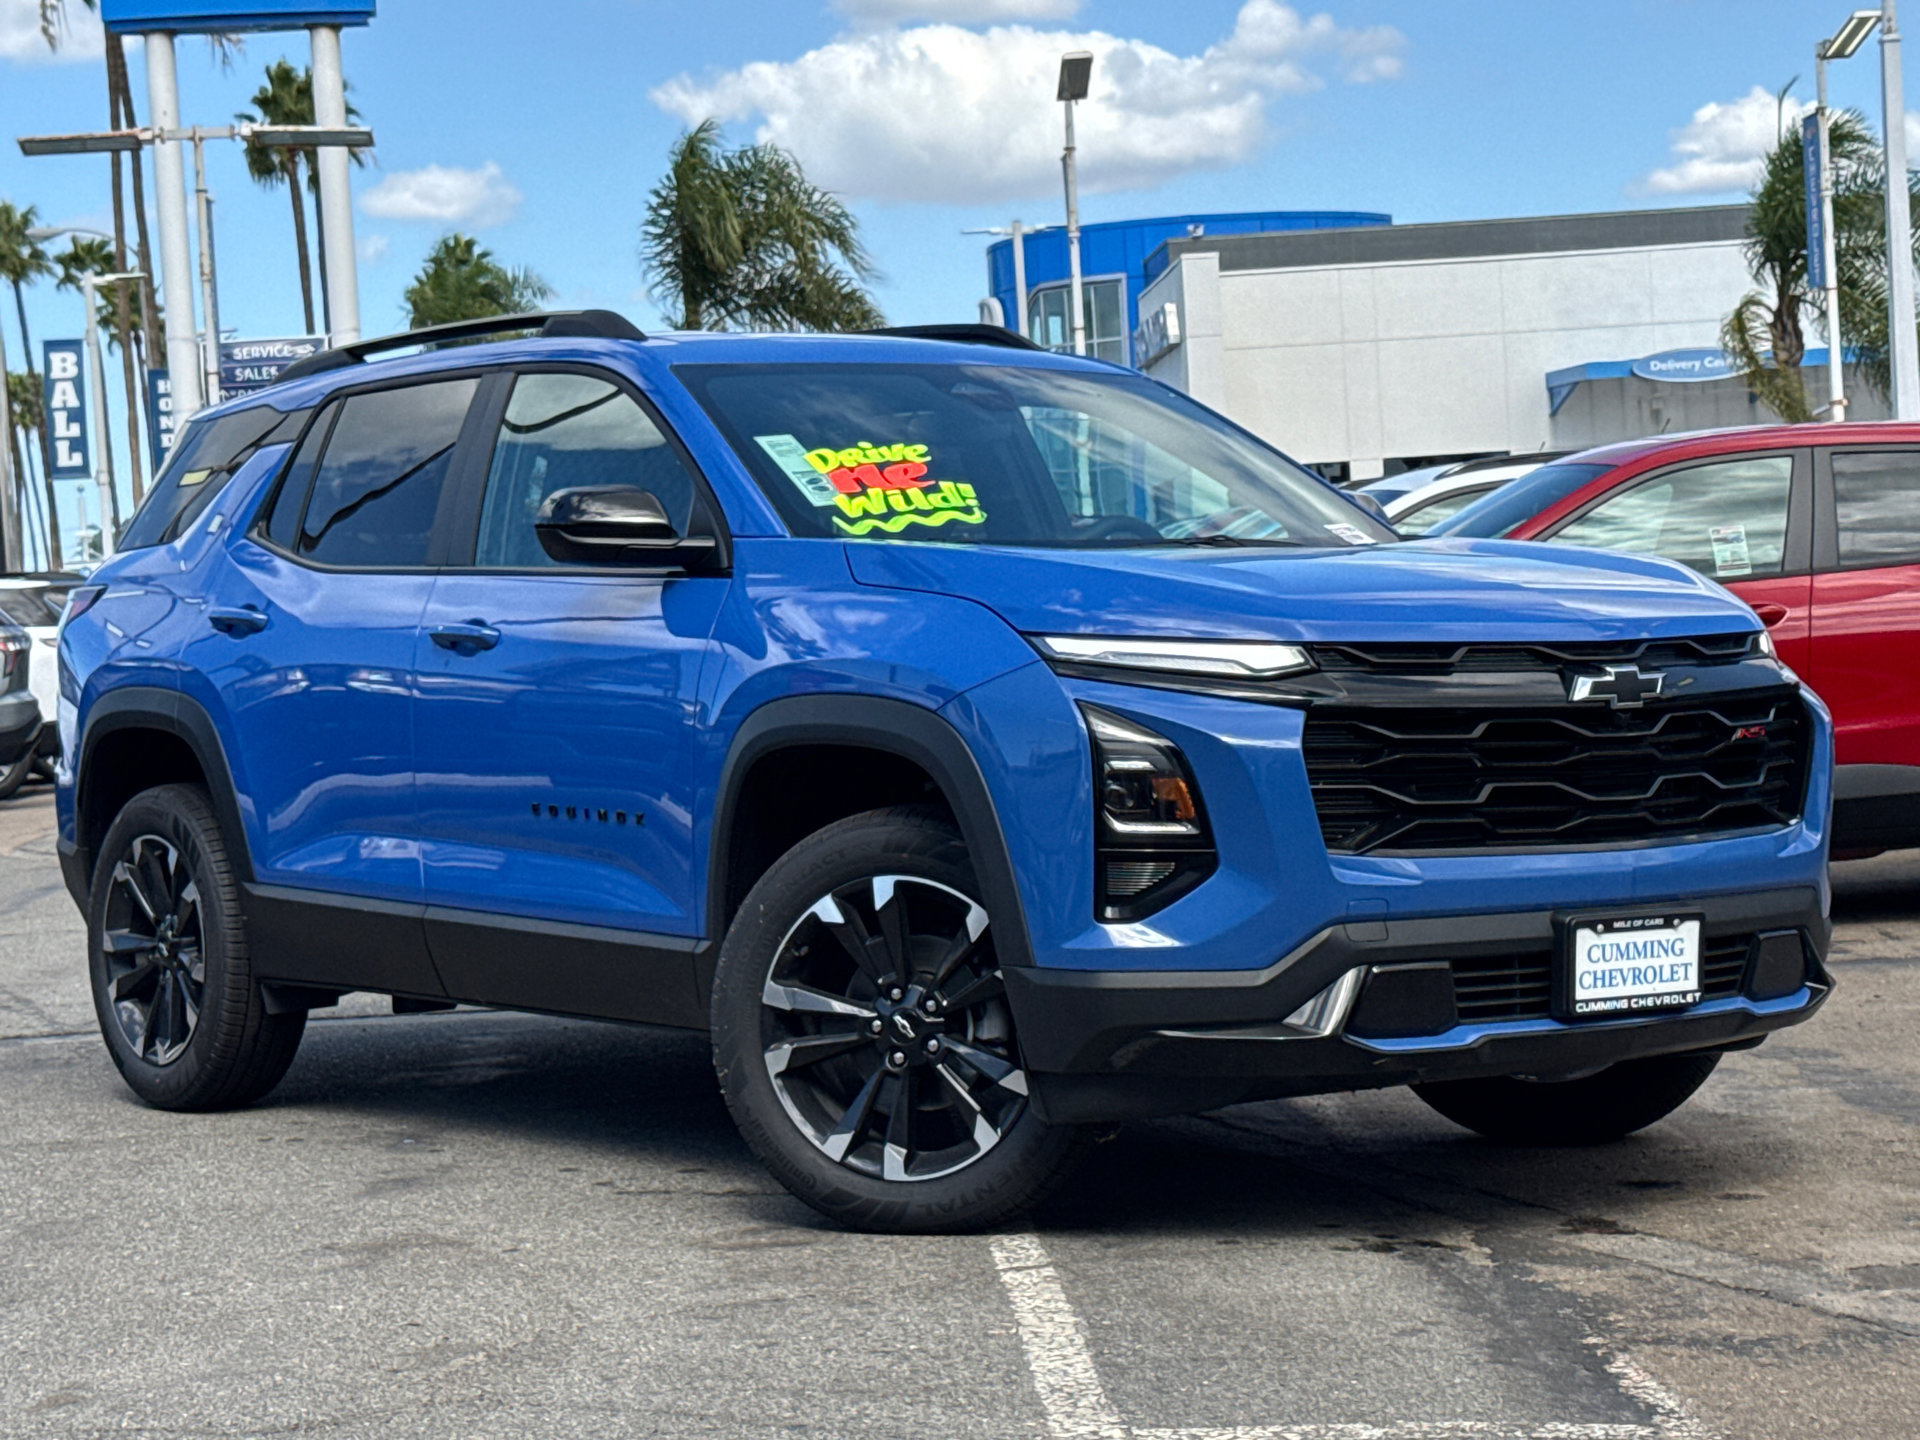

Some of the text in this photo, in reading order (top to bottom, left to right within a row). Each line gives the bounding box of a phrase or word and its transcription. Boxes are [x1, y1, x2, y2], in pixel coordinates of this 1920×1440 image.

[232, 344, 293, 361] SERVICE
[1649, 359, 1701, 373] Delivery
[49, 351, 84, 468] BALL
[833, 480, 979, 518] Wild!
[531, 802, 645, 826] EQUINOX
[1613, 918, 1664, 929] MILE OF CARS
[1588, 938, 1684, 963] CUMMING
[1579, 962, 1693, 990] CHEVROLET
[1575, 993, 1701, 1013] CUMMING CHEVROLET
